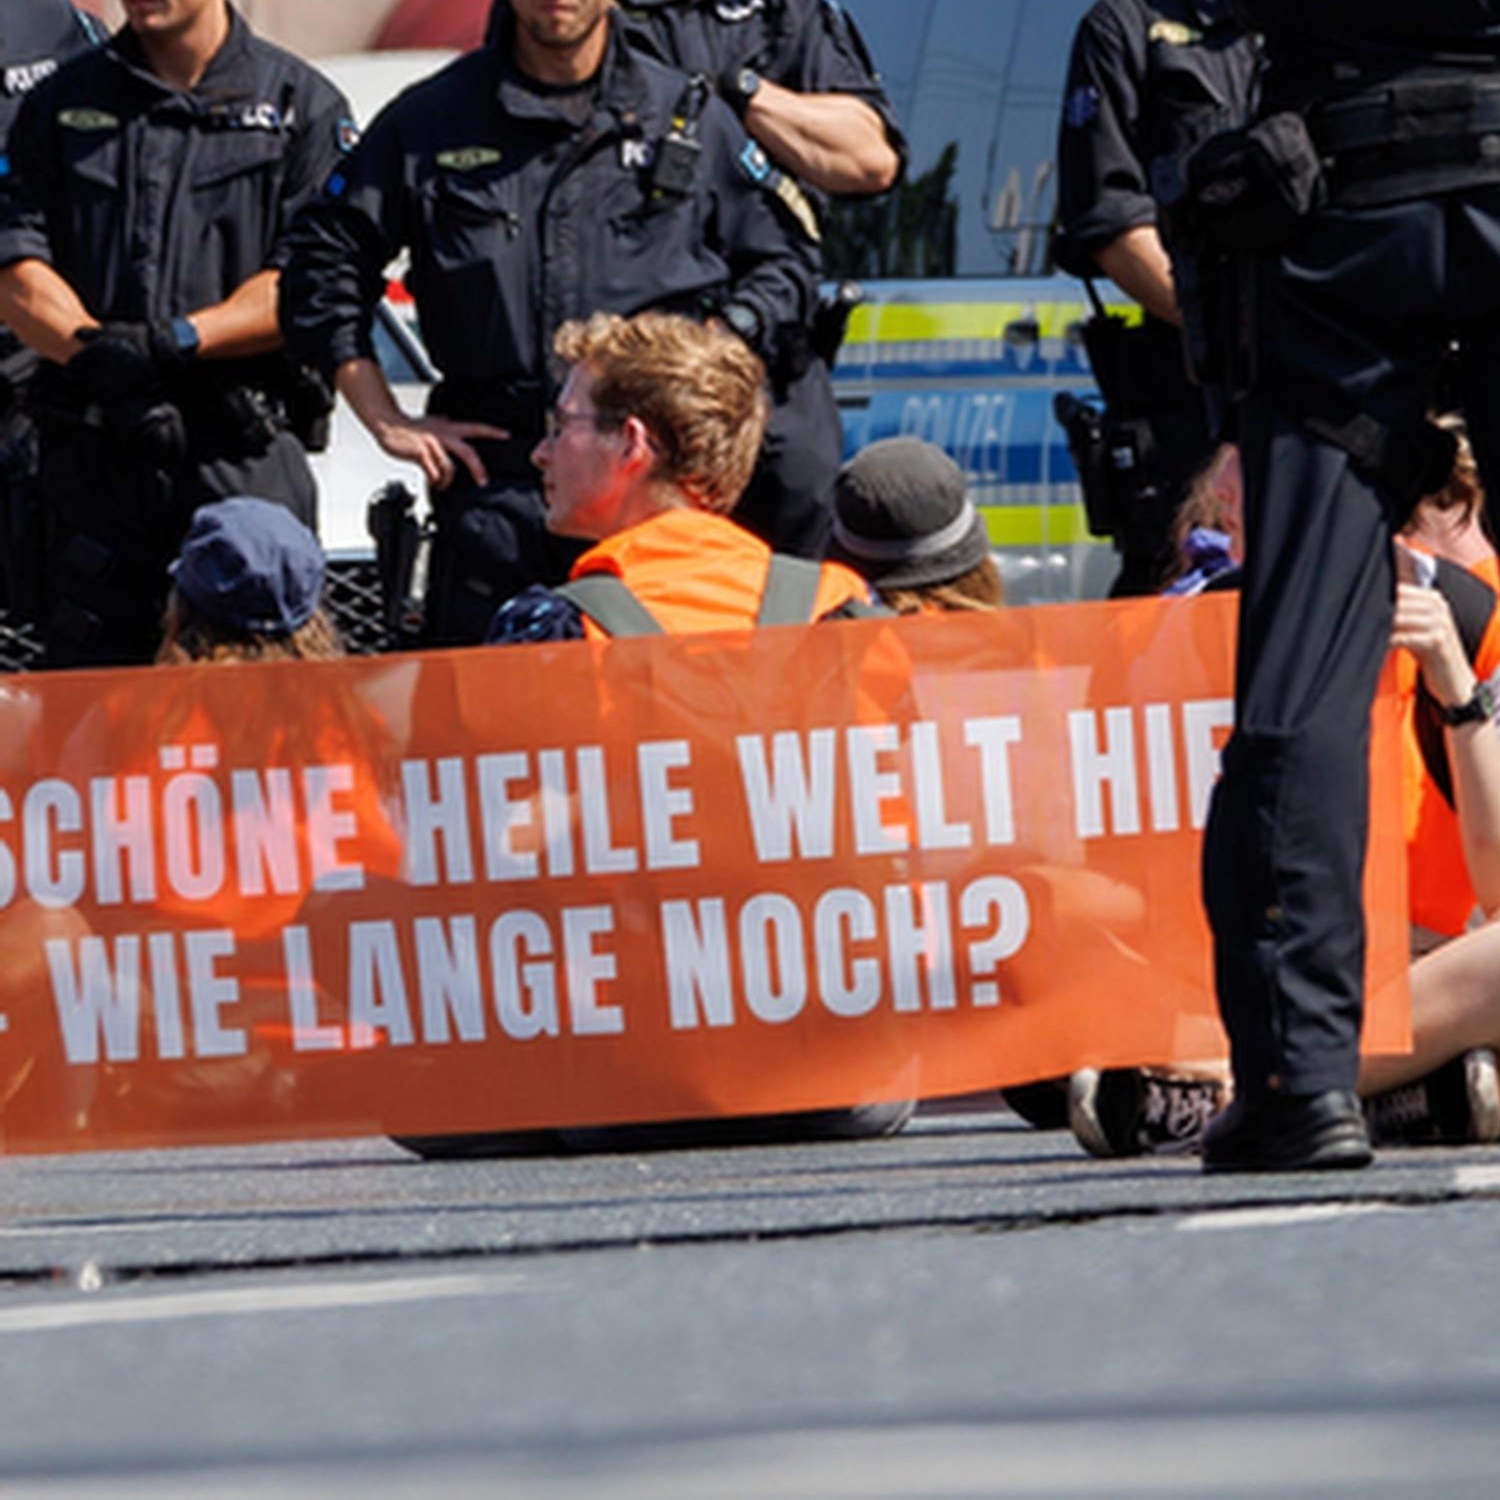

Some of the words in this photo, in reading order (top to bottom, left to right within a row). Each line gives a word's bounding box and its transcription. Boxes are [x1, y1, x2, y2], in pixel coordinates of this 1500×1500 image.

[0, 744, 364, 910] CHÖNE
[401, 739, 700, 886] HEILE
[735, 715, 1022, 863] WELT
[45, 929, 248, 1065] WIE
[282, 905, 625, 1053] LANGE
[660, 875, 1030, 1031] NOCH?
